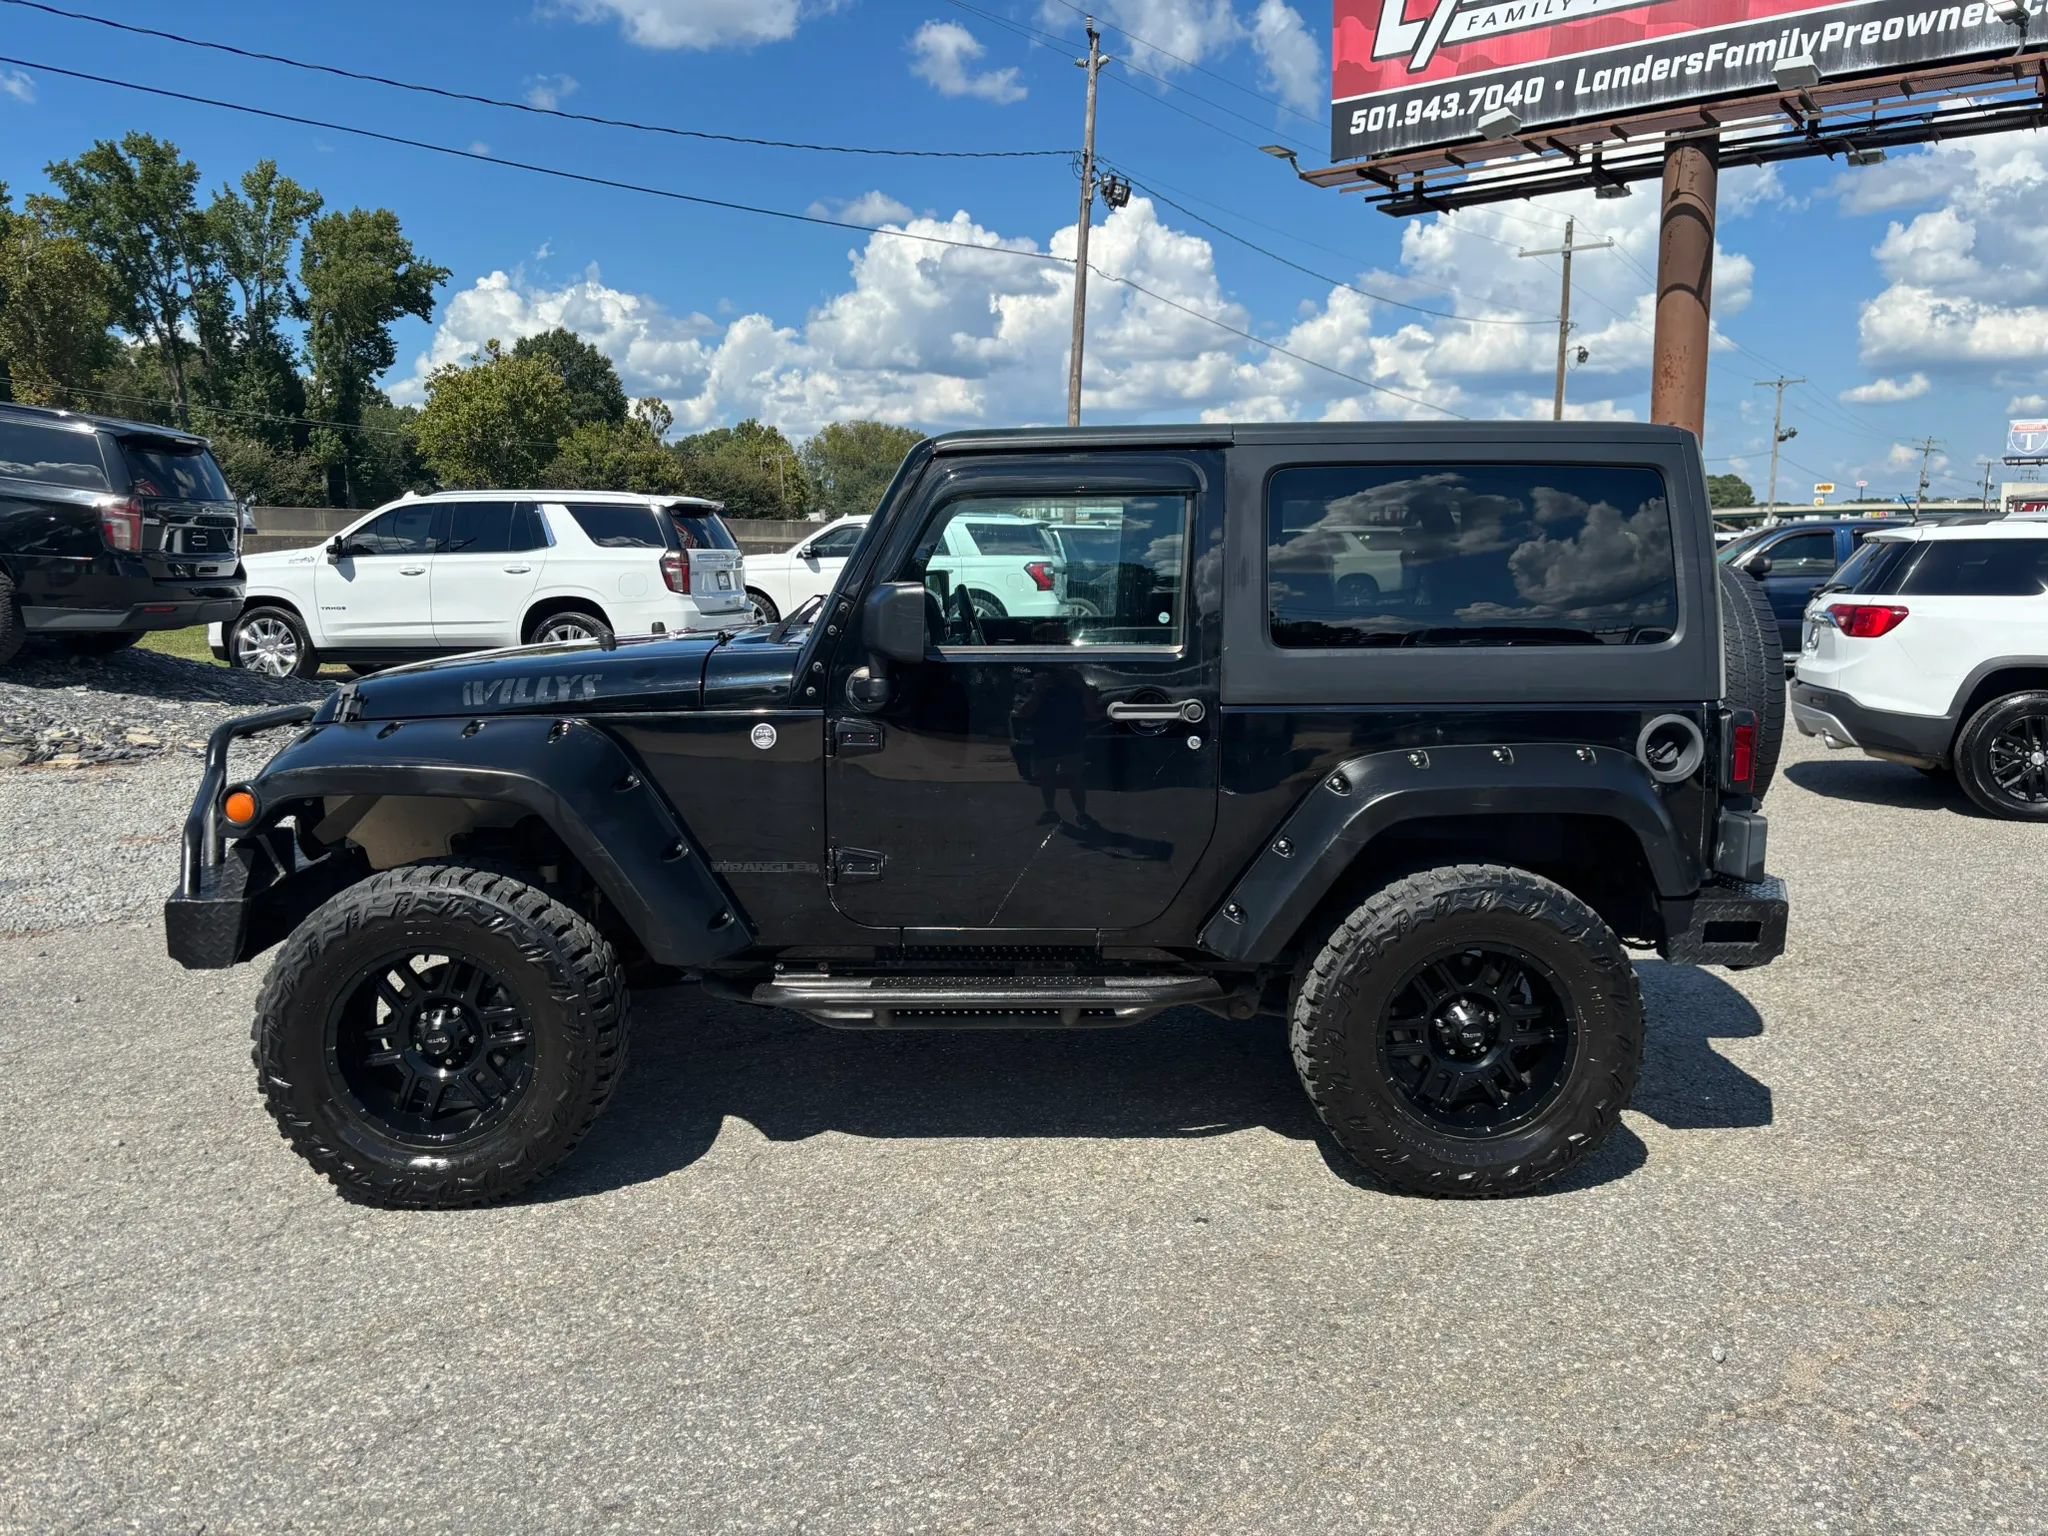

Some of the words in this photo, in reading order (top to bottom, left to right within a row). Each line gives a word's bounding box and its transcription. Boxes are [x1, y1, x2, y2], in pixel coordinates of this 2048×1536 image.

[1466, 0, 1572, 31] FAMILY
[1349, 76, 1545, 135] 501.943.7040
[462, 673, 603, 706] WILLYS
[711, 861, 819, 873] WRANGLER
